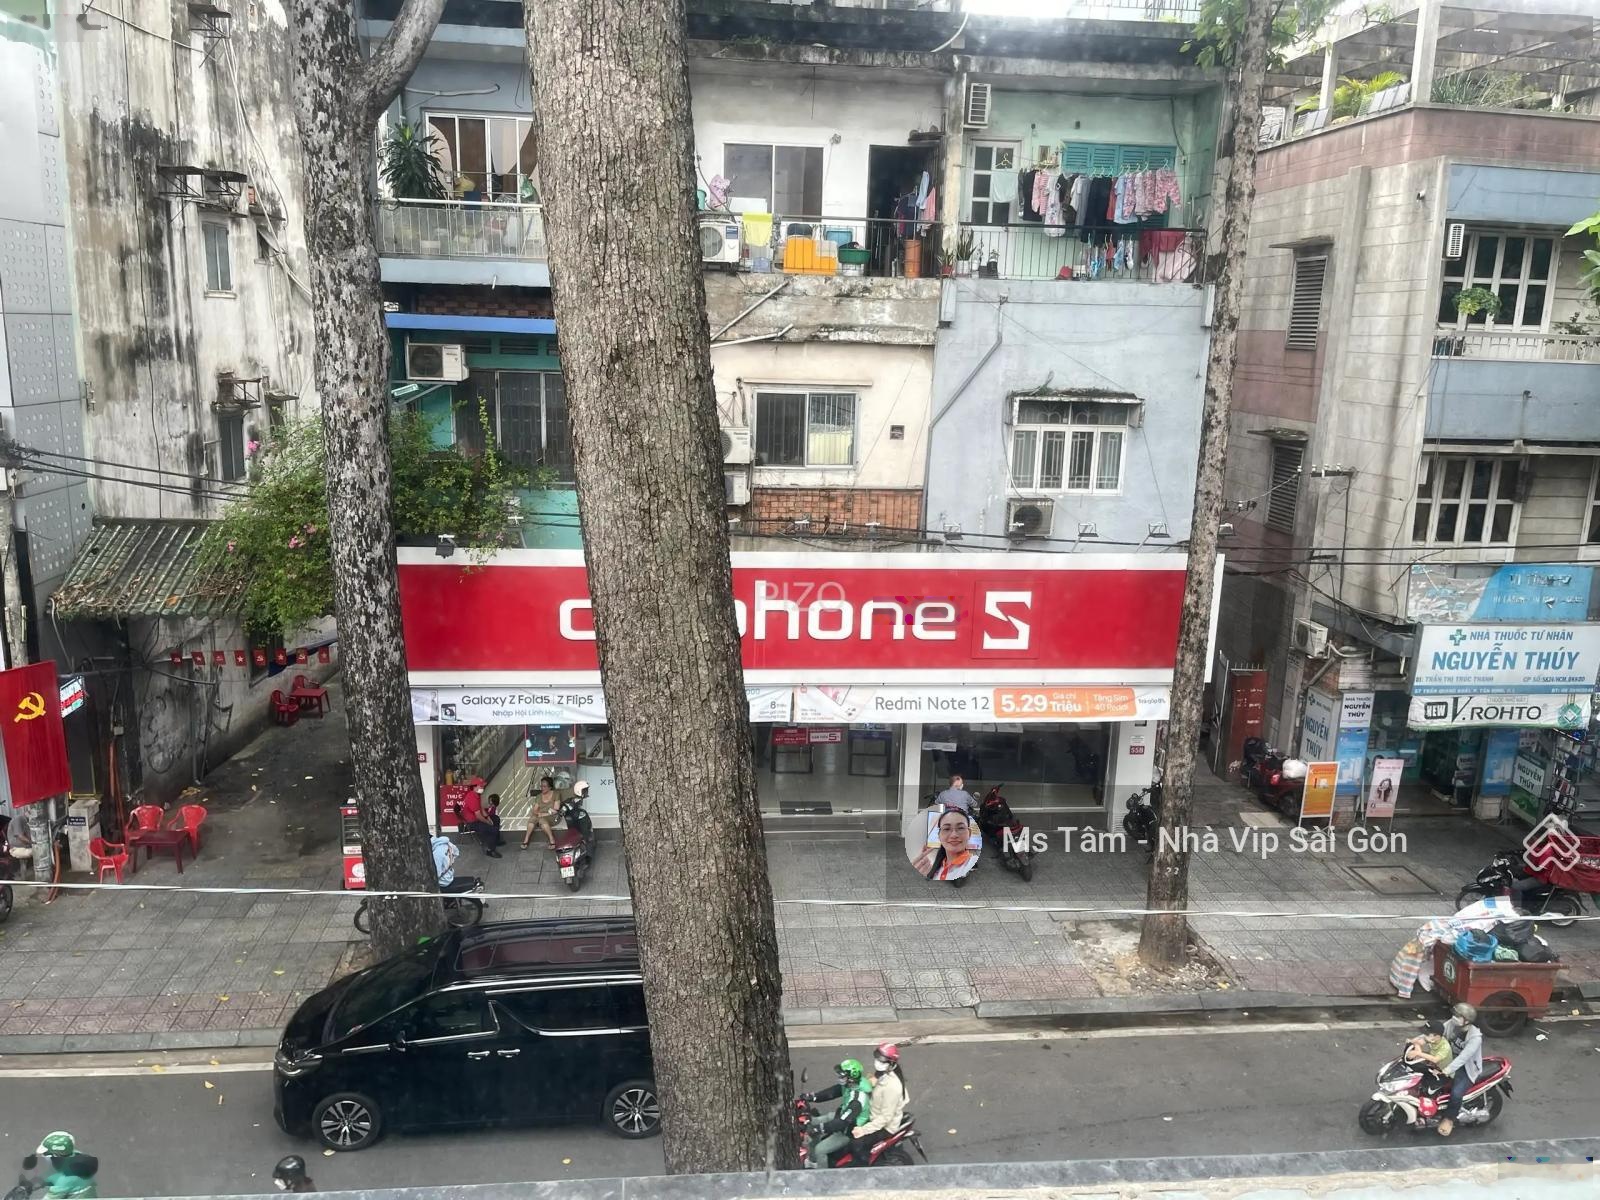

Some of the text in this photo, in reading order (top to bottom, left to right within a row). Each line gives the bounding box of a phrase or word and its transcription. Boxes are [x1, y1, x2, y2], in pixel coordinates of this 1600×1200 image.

[1469, 627, 1573, 641] NHÀ THUỐC TƯ NHÂN
[1432, 643, 1579, 670] NGUYỄN THÚY
[462, 694, 506, 706] Galaxy
[509, 695, 516, 704] Z
[518, 694, 550, 704] Fold5
[557, 696, 564, 704] Z
[567, 695, 594, 707] Flip5
[875, 696, 990, 710] Redmi Note 12
[1001, 694, 1048, 713] 5.29
[1050, 700, 1082, 715] Triệu
[1344, 701, 1371, 710] NGUYỄN
[492, 709, 514, 717] Nhập
[1347, 710, 1366, 718] THÚY
[1427, 705, 1447, 718] NEW
[1304, 716, 1330, 742] NGUYỄN
[1306, 738, 1322, 759] THÚY
[1517, 763, 1542, 782] NGUYỄN
